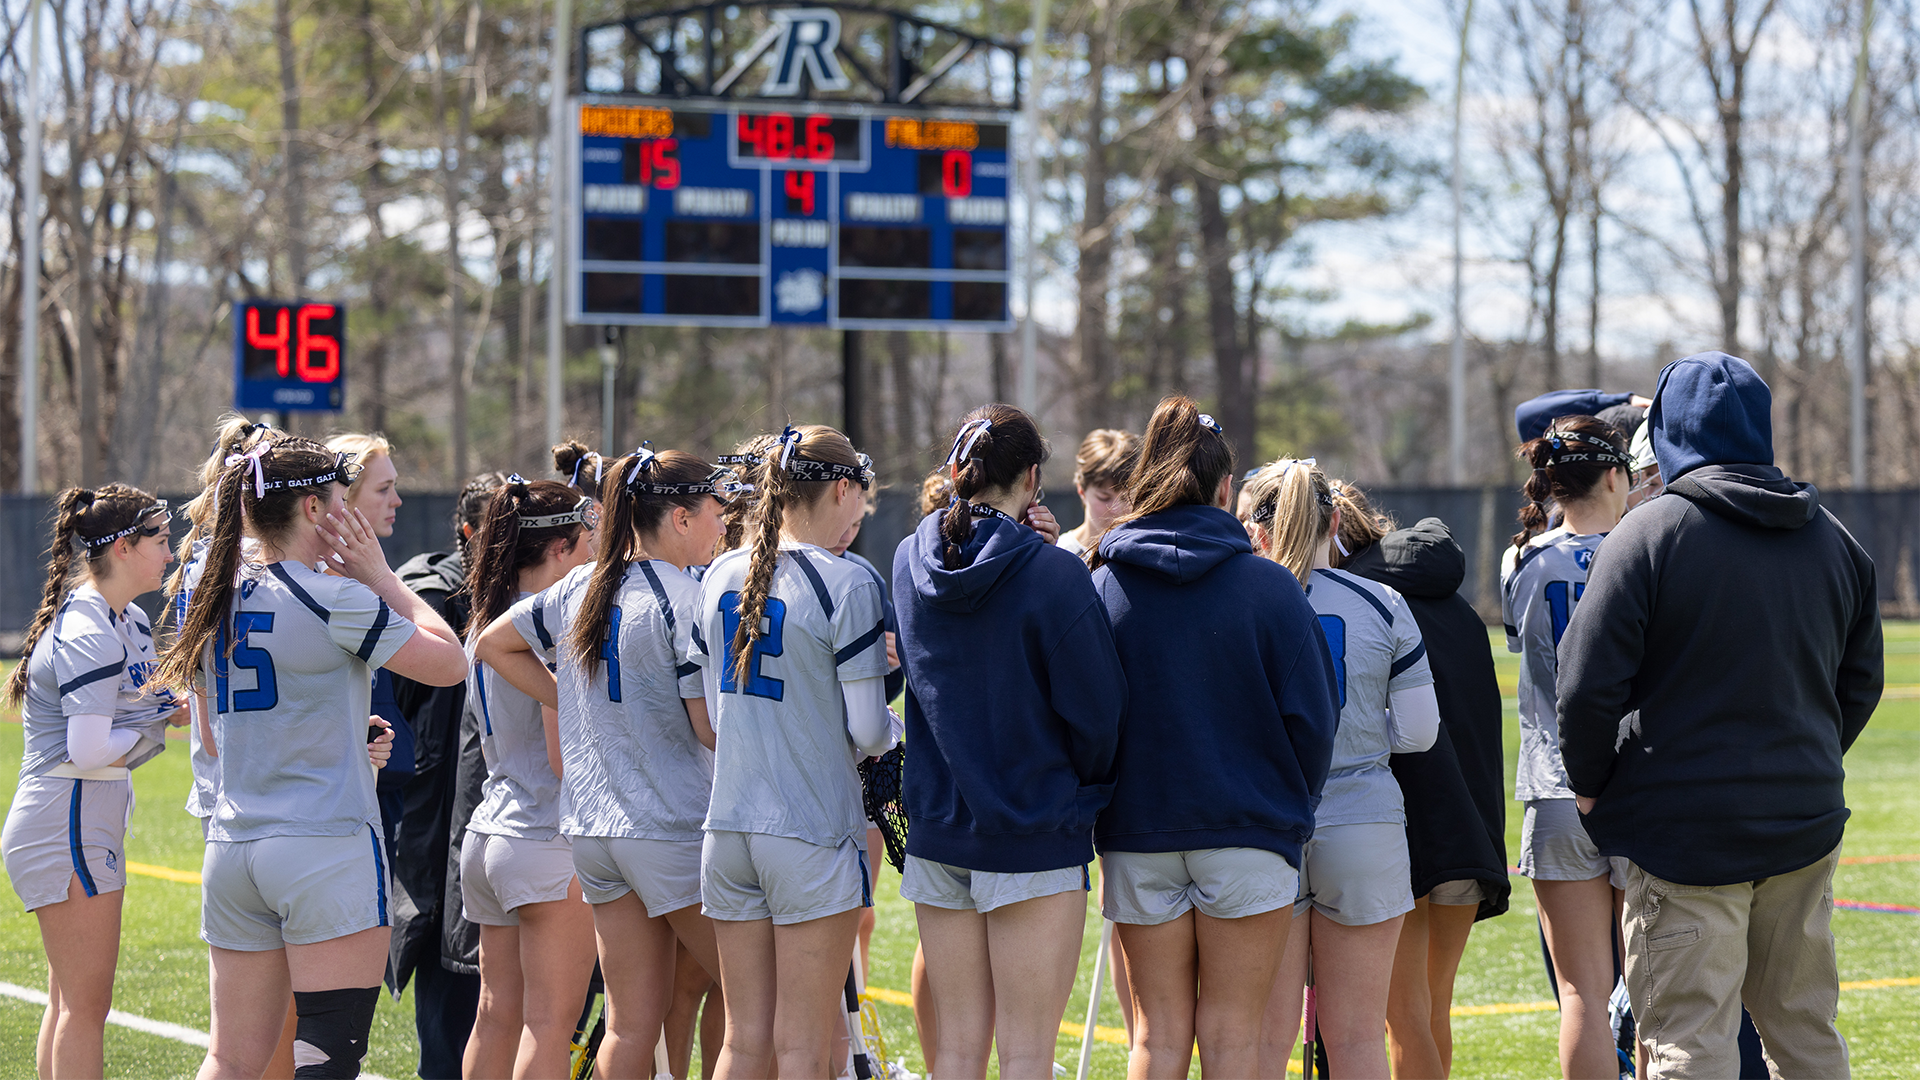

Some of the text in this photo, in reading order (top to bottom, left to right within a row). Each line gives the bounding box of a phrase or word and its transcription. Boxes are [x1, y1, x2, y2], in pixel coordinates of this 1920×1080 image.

[762, 7, 851, 96] R
[639, 138, 681, 189] 15
[942, 150, 972, 199] 0
[785, 169, 815, 215] 4
[246, 303, 340, 383] 46
[288, 478, 313, 488] GAIT
[316, 472, 337, 484] GAIT
[833, 464, 855, 475] STX
[1560, 453, 1589, 463] STX
[652, 485, 680, 494] STX
[688, 484, 714, 494] STX
[551, 514, 576, 525] STX
[718, 590, 787, 702] 12
[1544, 580, 1586, 673] 1
[213, 611, 279, 715] 15
